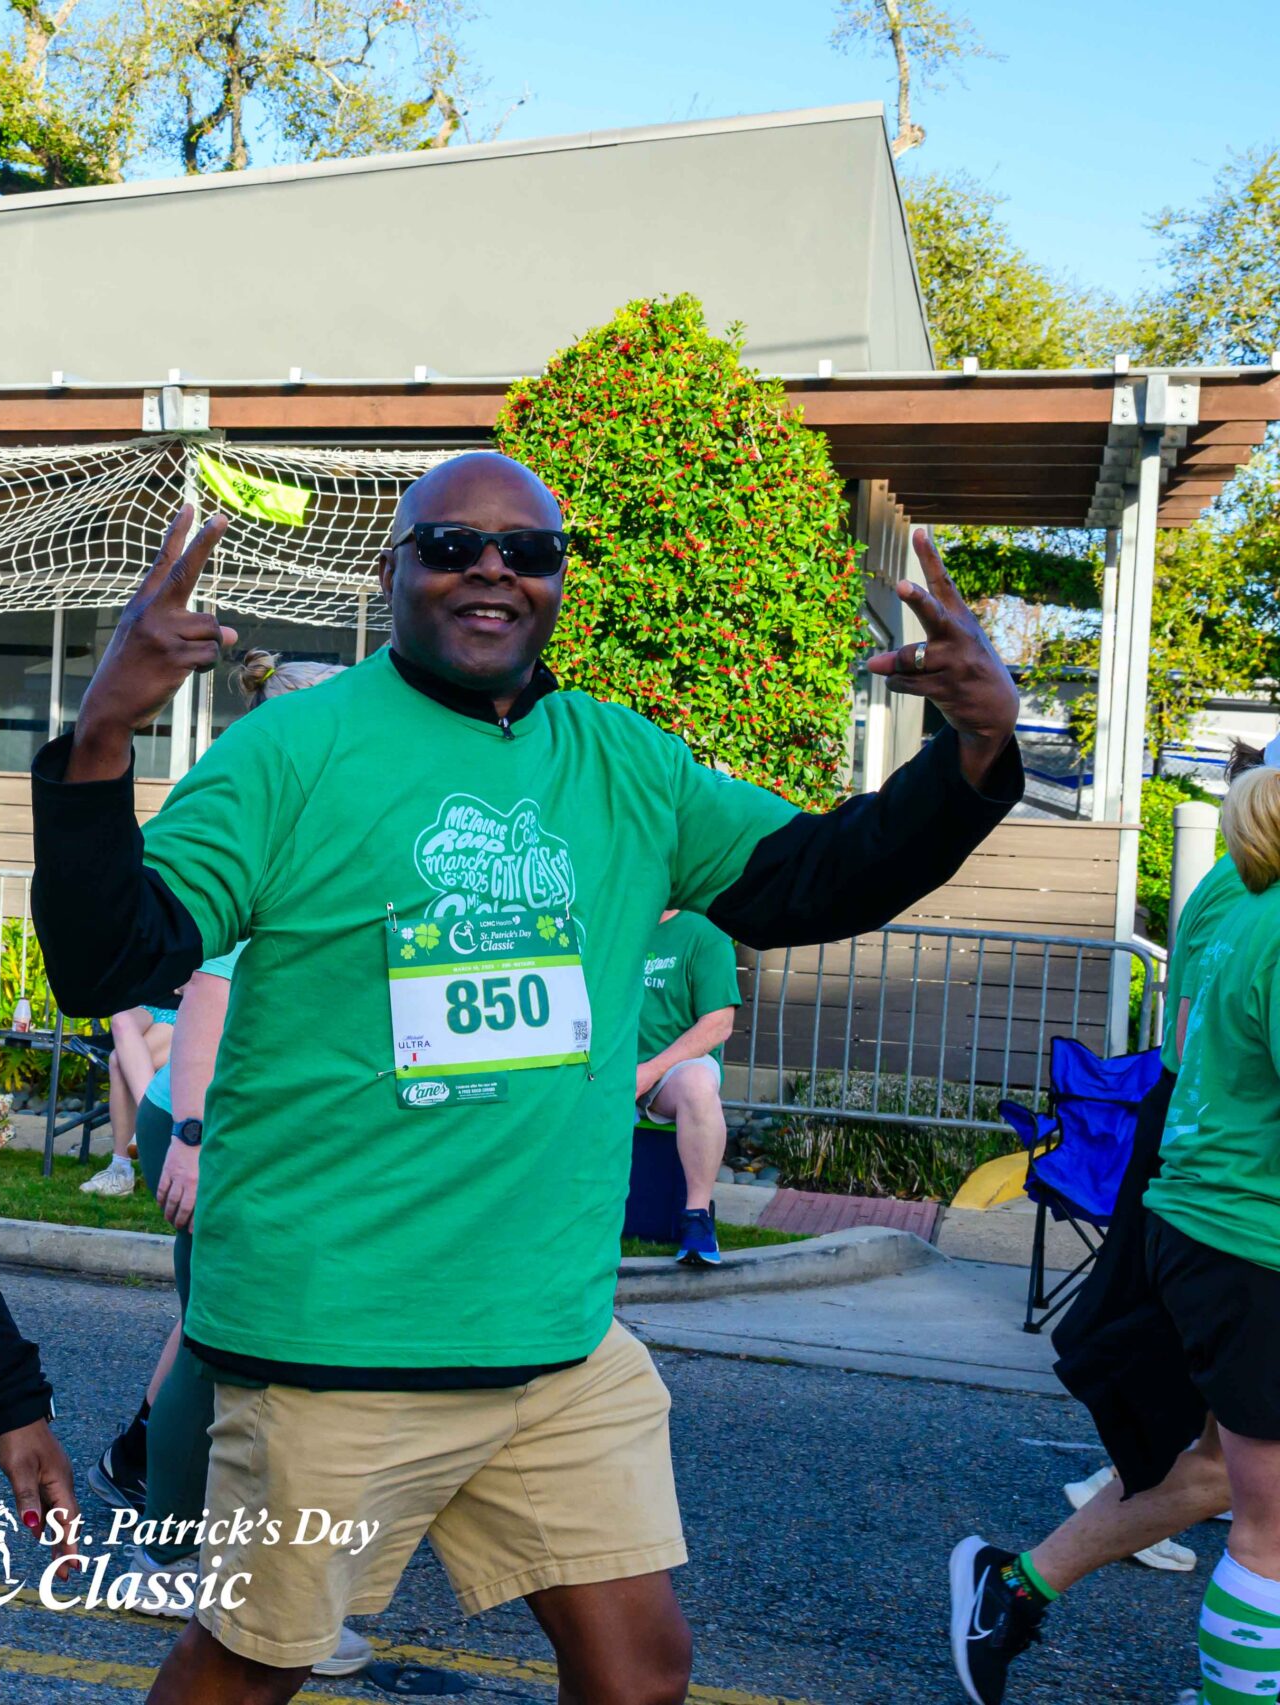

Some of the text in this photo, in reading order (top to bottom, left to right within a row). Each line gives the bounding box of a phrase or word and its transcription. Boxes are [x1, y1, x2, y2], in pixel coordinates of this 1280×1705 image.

[445, 806, 508, 840] METAIRIE
[422, 829, 506, 856] ROAD
[422, 850, 495, 875] March
[461, 871, 489, 893] 2025
[491, 855, 522, 901] CITY
[480, 920, 496, 928] LCMC
[480, 930, 532, 940] St. Patrick's Day
[480, 939, 515, 952] Classic
[445, 974, 550, 1035] 850
[398, 1040, 431, 1050] ULTRA
[405, 1082, 448, 1104] Cane's
